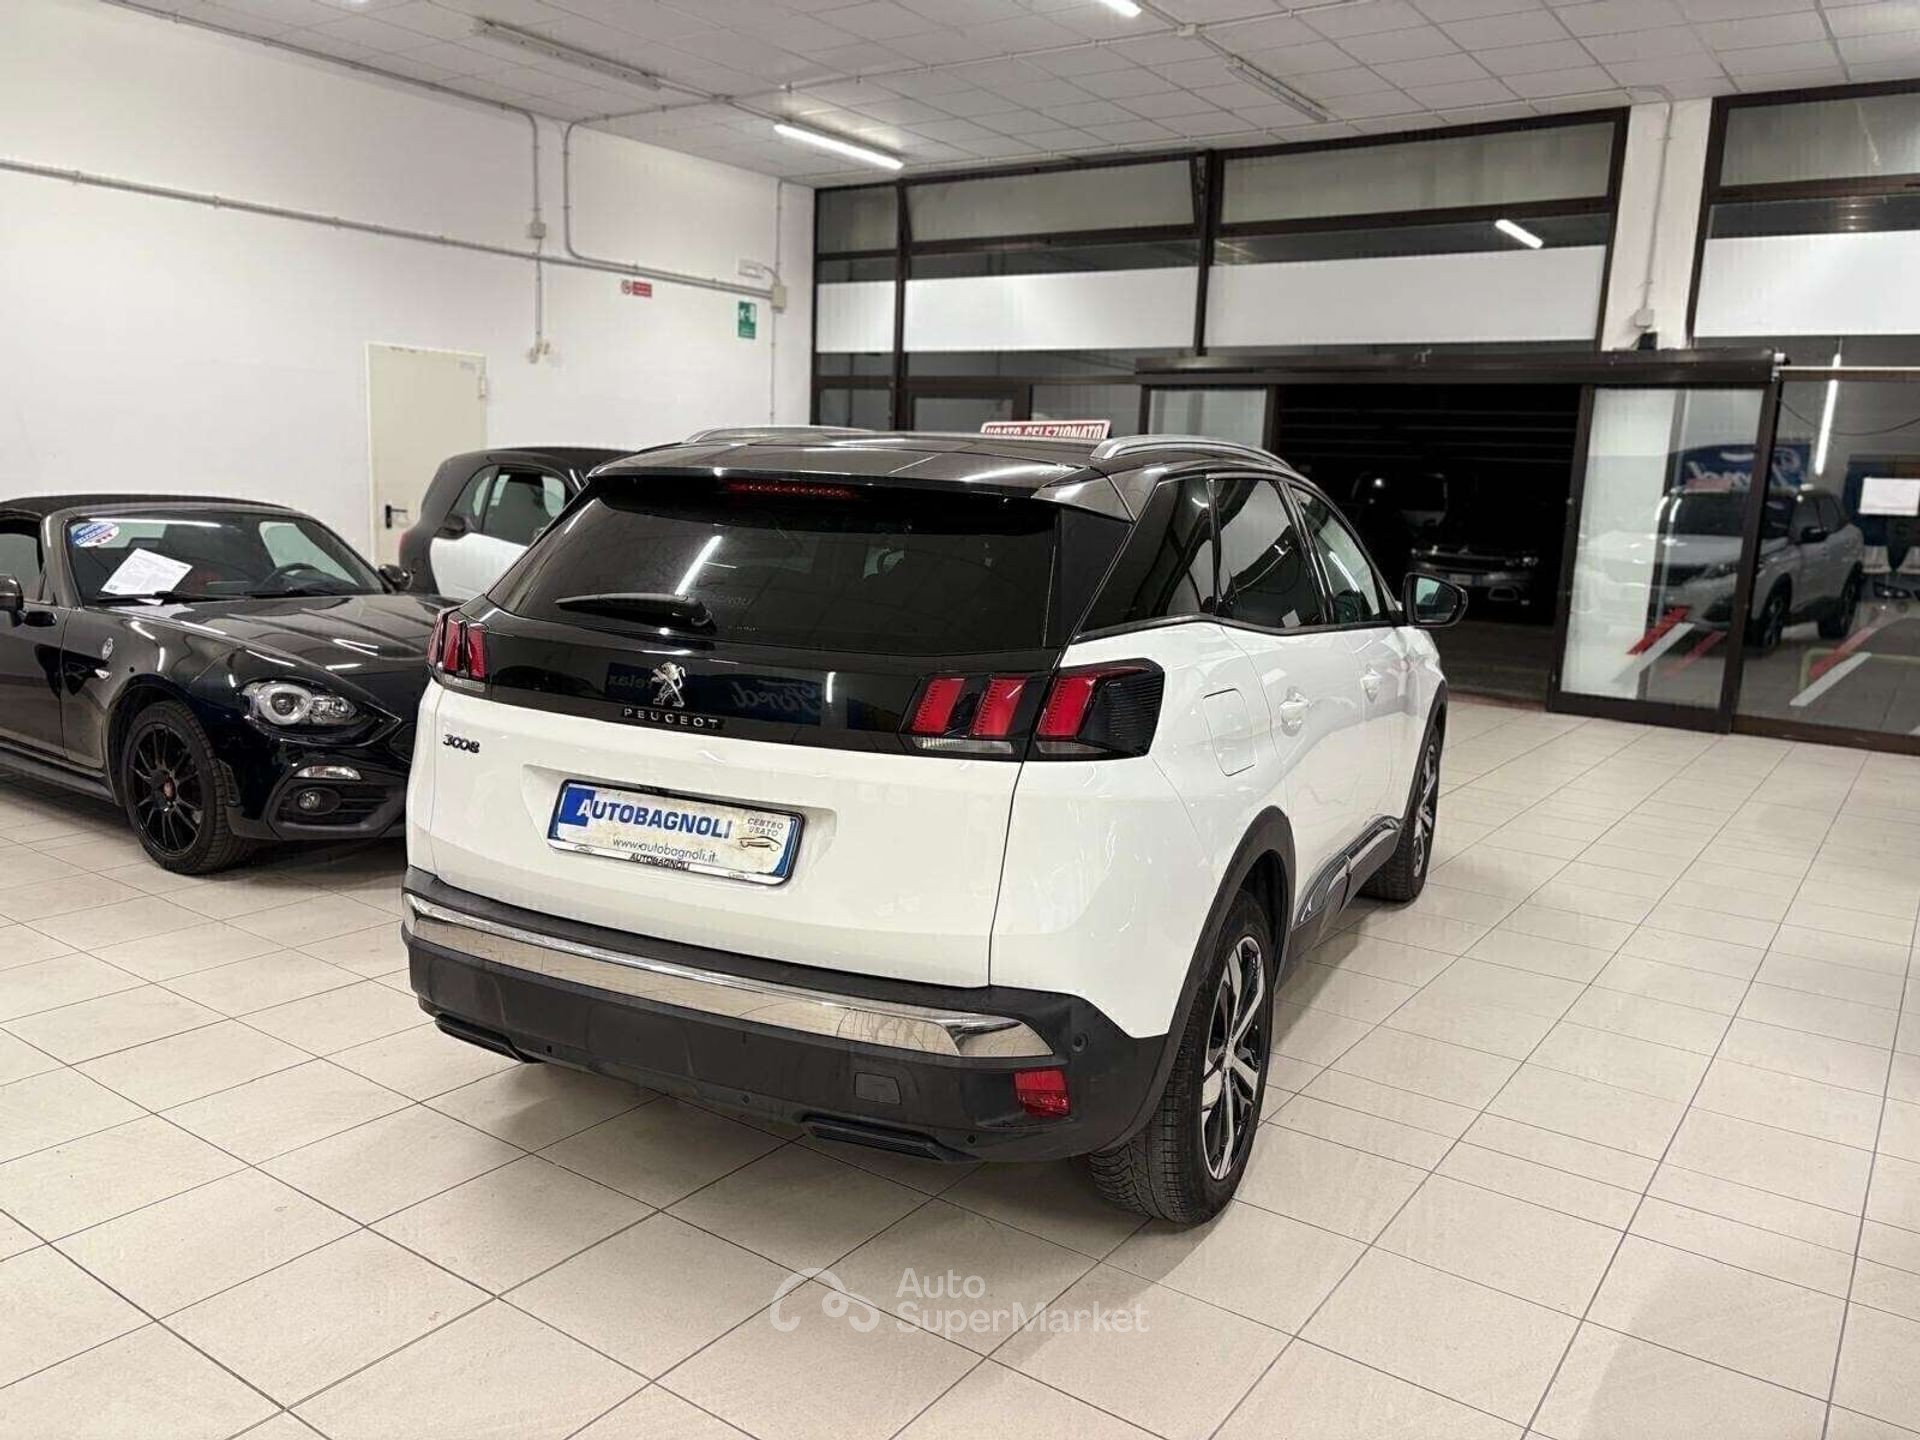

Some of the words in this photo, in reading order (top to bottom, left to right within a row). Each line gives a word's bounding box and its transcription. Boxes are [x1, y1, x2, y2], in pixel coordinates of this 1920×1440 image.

[624, 708, 718, 729] PEUGEOT
[442, 734, 480, 753] 3008
[577, 799, 732, 839] AUTOBAGNOLI
[747, 817, 784, 830] CENTRO
[749, 826, 779, 837] USATO
[612, 837, 717, 863] www.autobagnoli.it
[631, 852, 690, 871] AUTOBAGNOLI
